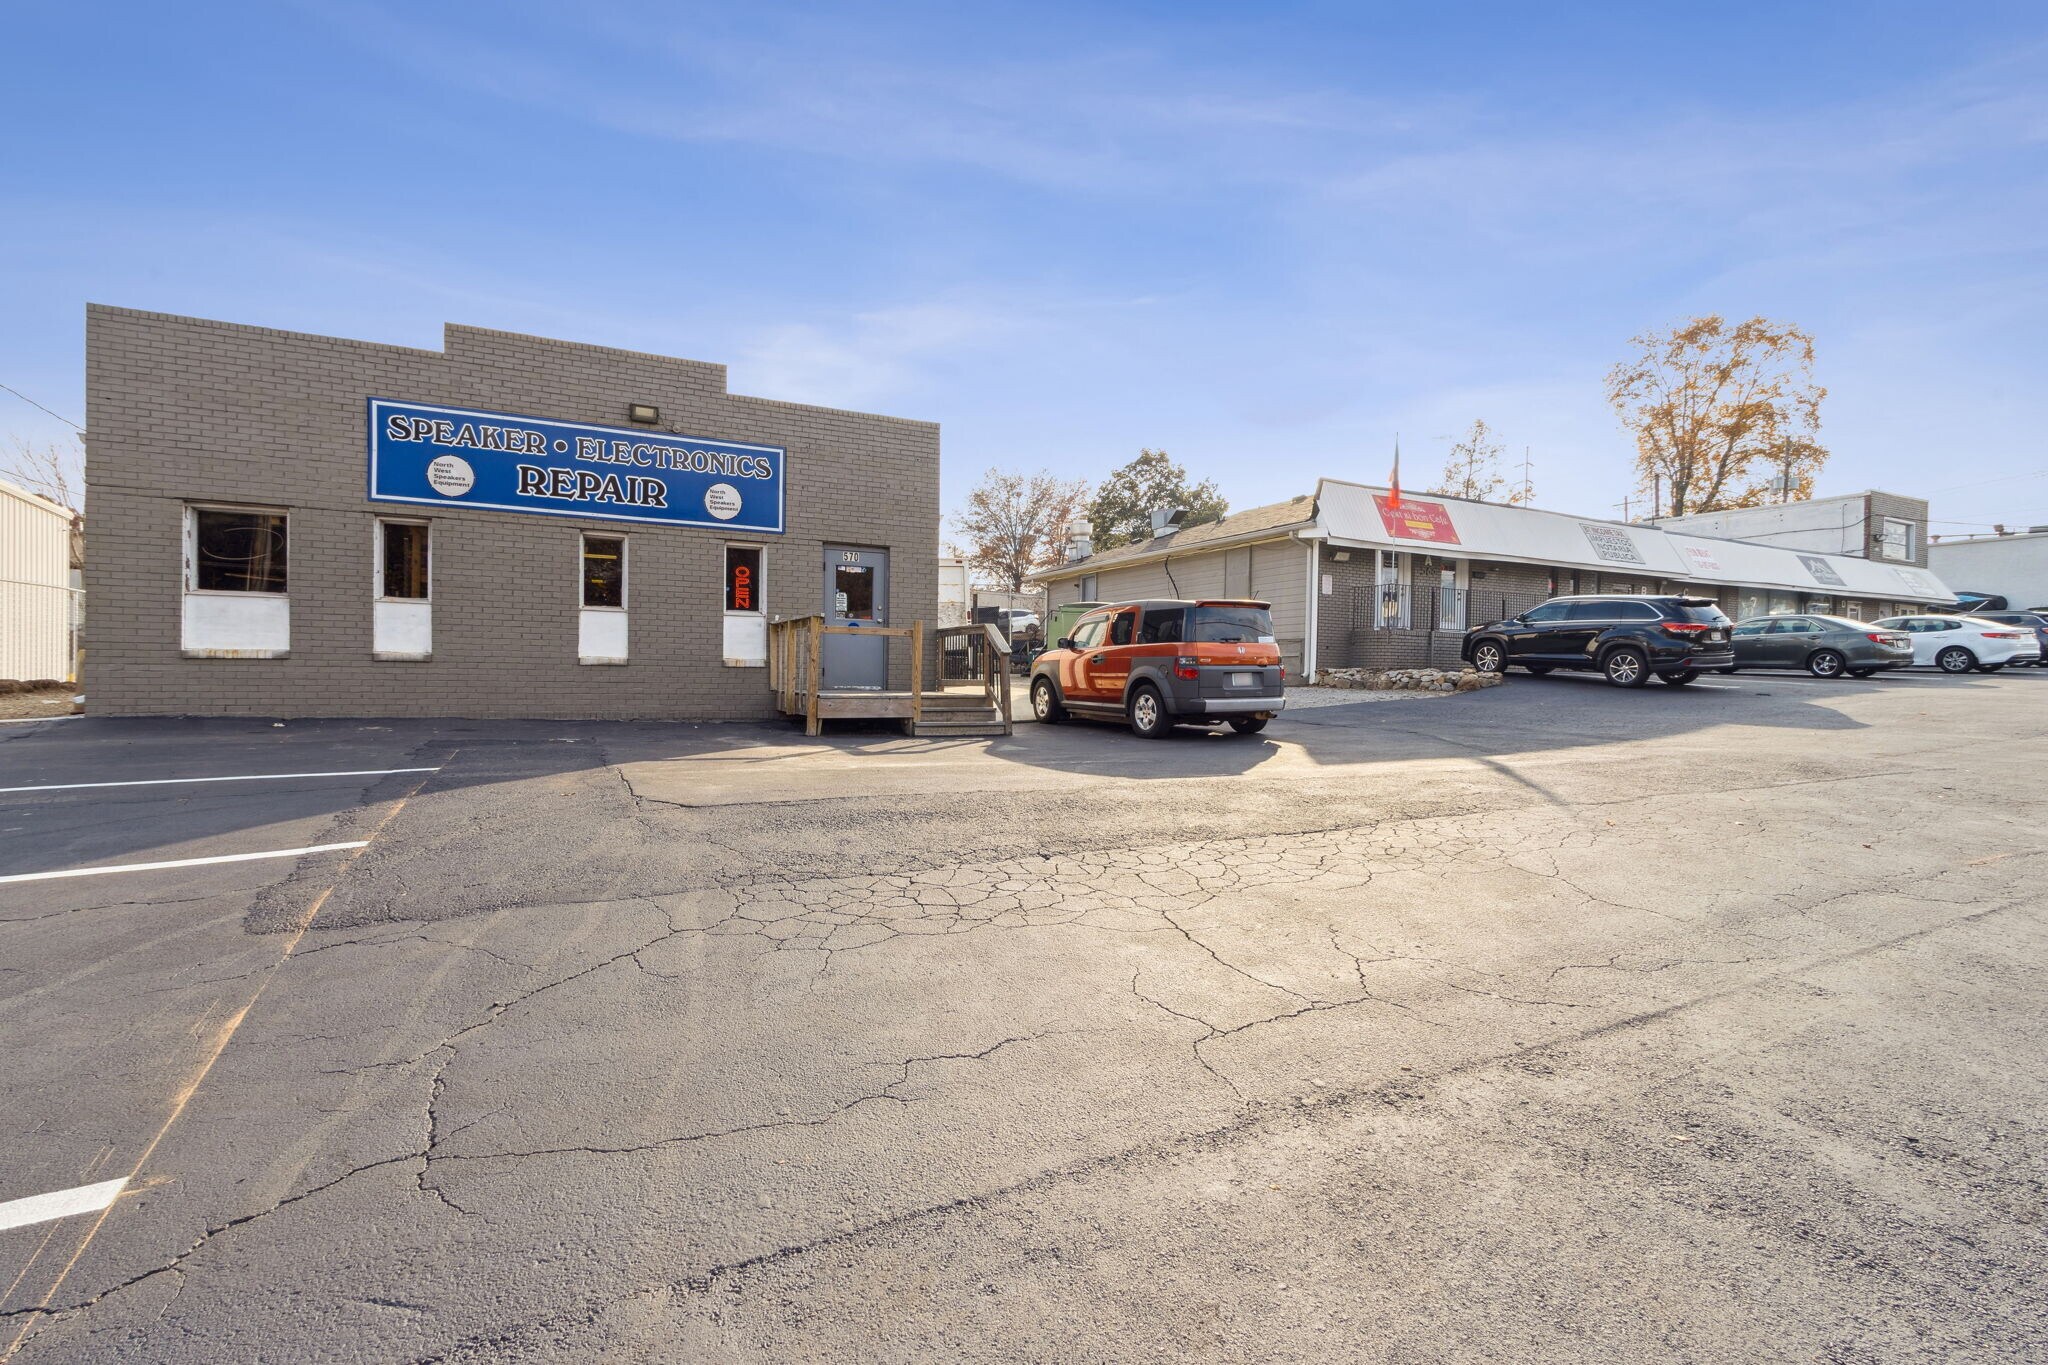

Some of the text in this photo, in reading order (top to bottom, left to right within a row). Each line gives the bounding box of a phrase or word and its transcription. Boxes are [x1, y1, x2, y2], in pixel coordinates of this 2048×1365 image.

[387, 414, 773, 480] SPEAKER ELECTRONICS
[433, 480, 470, 488] Equipment
[516, 464, 667, 508] REPAIR
[709, 504, 739, 512] Equipment
[1590, 534, 1632, 547] IMPUESTOS
[1597, 543, 1632, 554] NOTARIA
[843, 551, 859, 562] 570
[1424, 555, 1433, 567] A
[735, 565, 751, 609] OPEN
